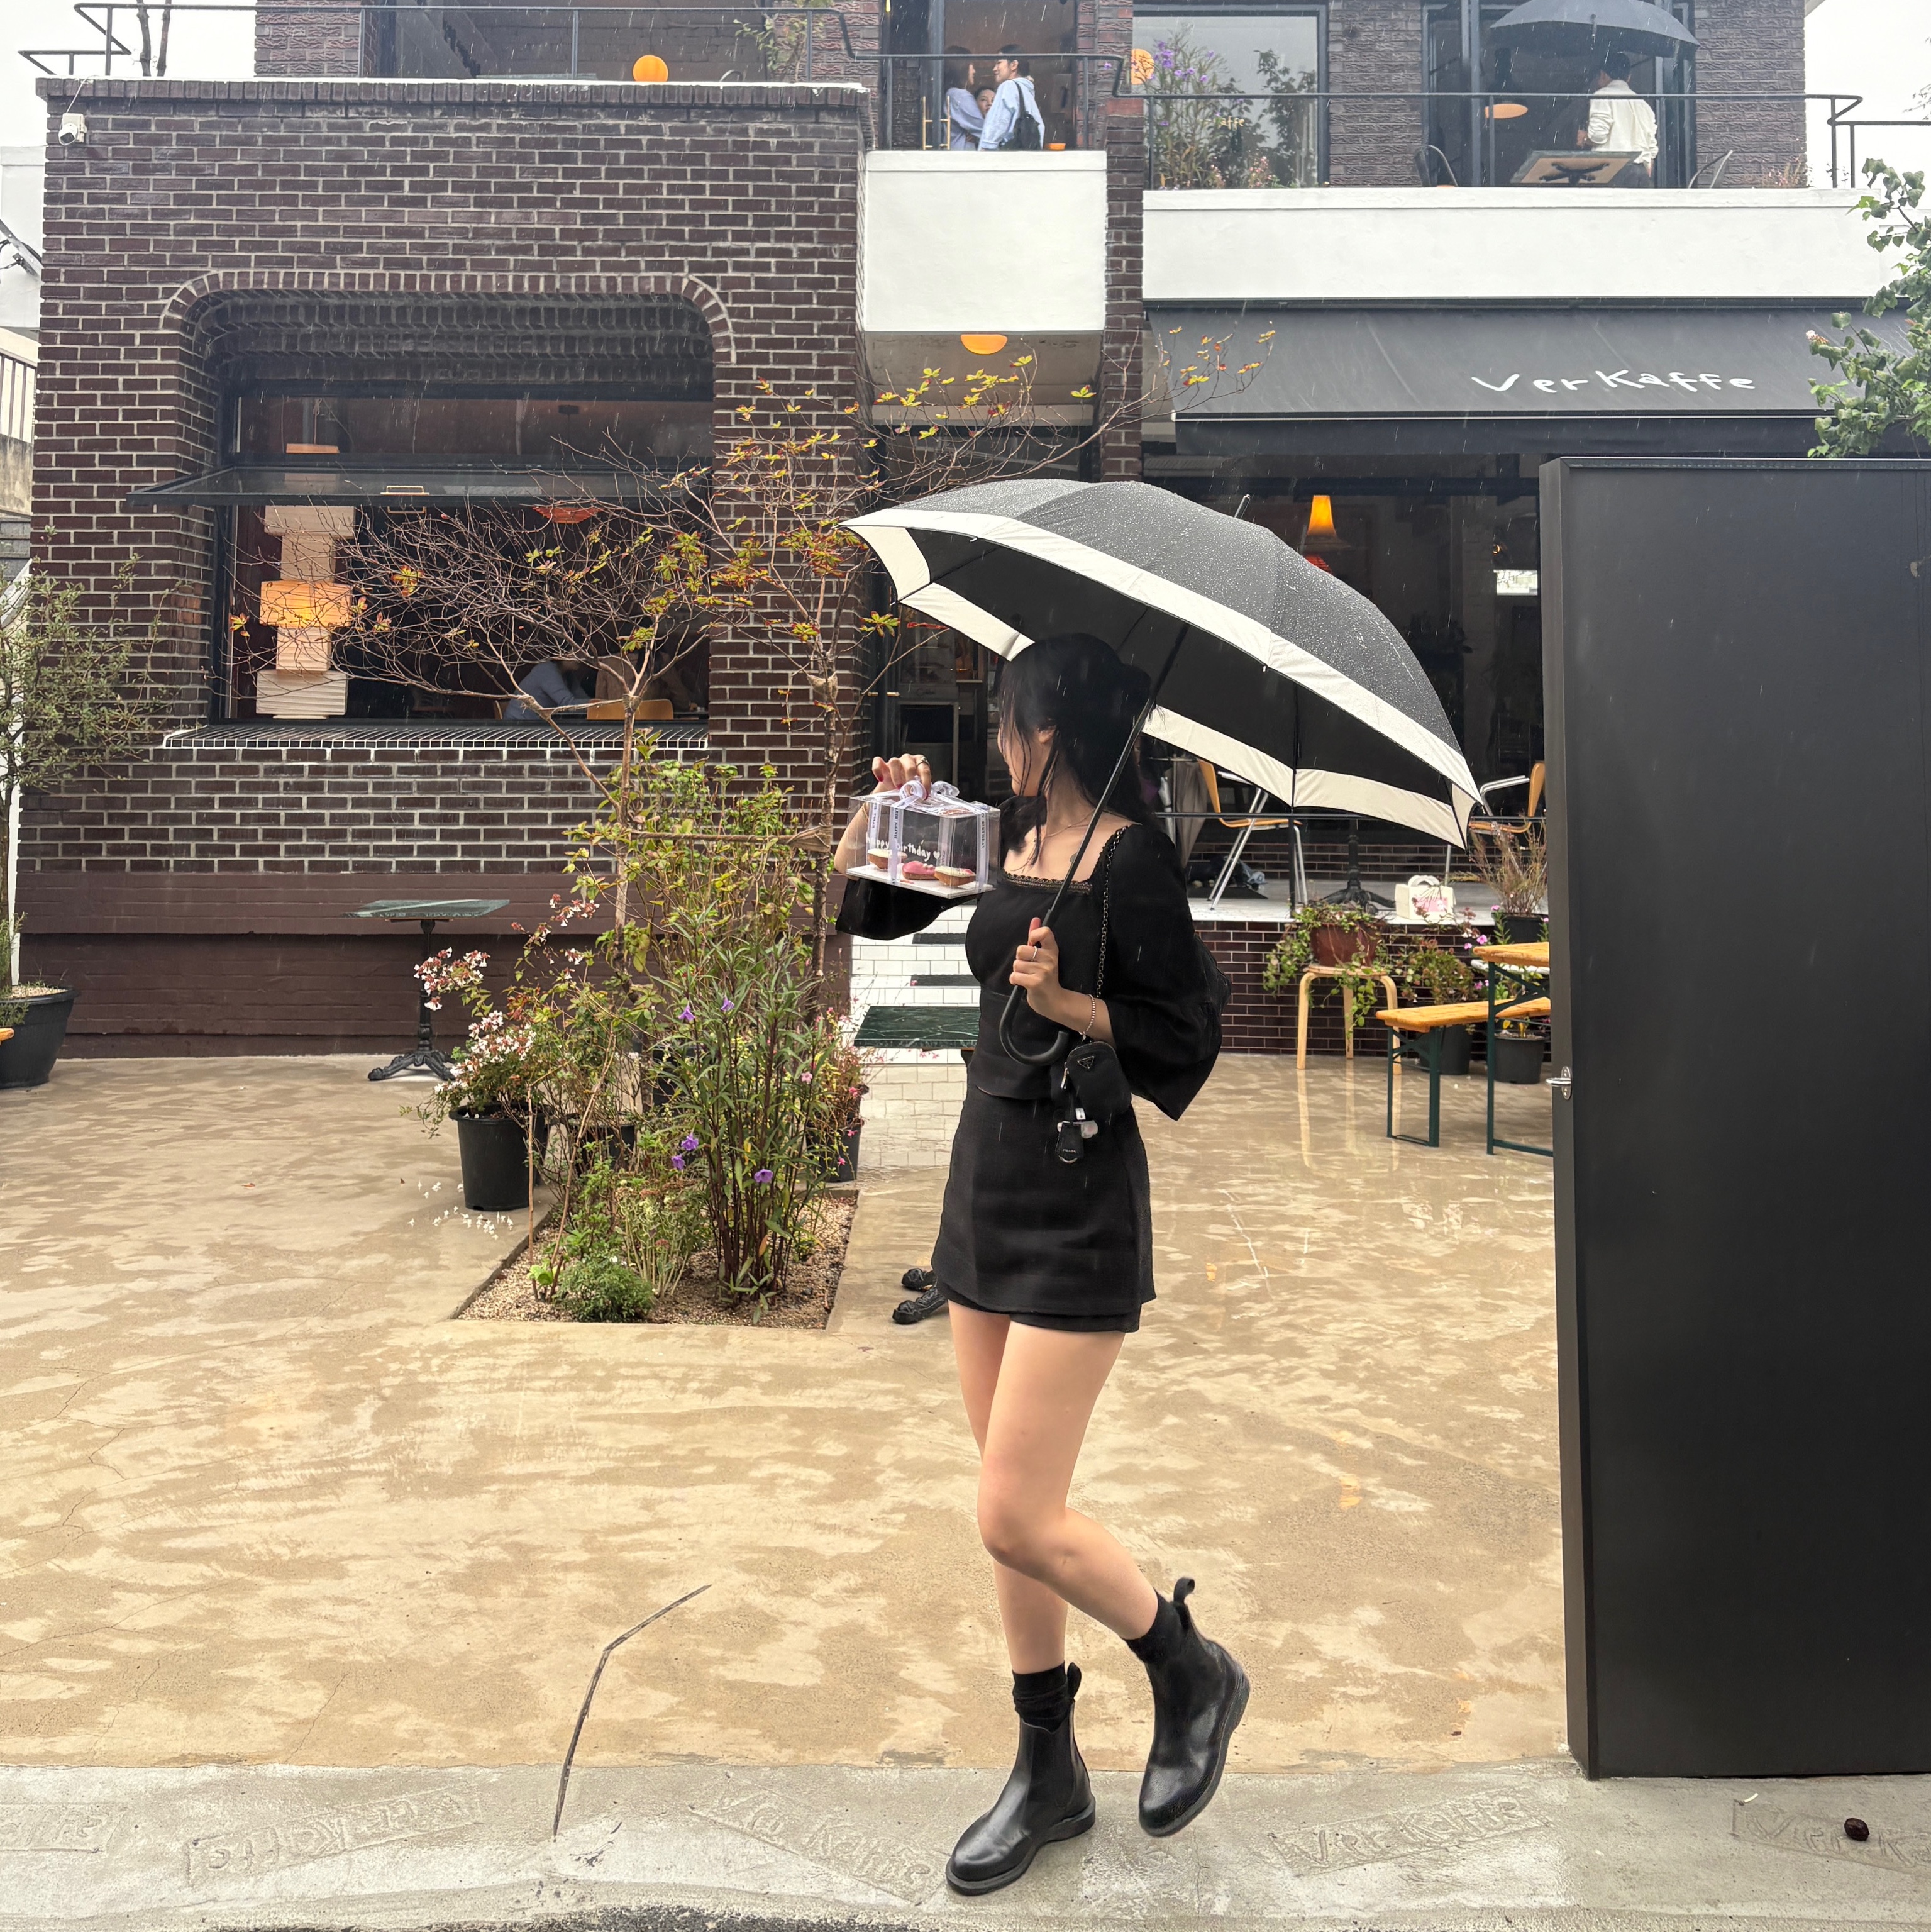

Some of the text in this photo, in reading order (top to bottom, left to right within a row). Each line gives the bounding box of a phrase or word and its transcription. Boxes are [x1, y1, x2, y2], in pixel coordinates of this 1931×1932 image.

[1213, 116, 1245, 130] affe
[1471, 370, 1756, 393] Ver Kaffe
